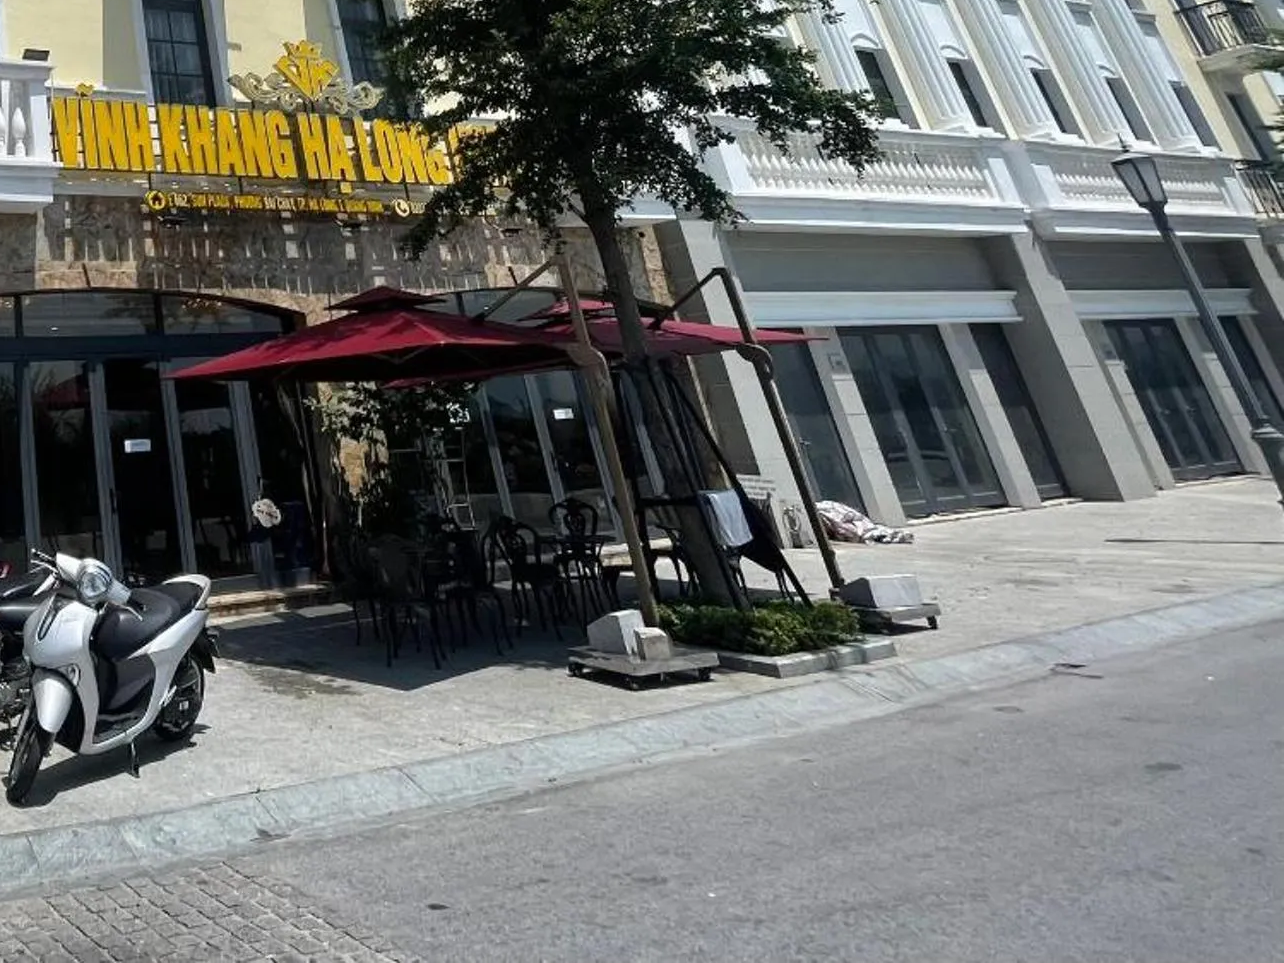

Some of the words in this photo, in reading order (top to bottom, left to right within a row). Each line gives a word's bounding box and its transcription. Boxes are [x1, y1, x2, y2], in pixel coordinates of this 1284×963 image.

[157, 103, 296, 179] KHANG
[298, 112, 354, 193] HẠ
[353, 116, 454, 185] LONG
